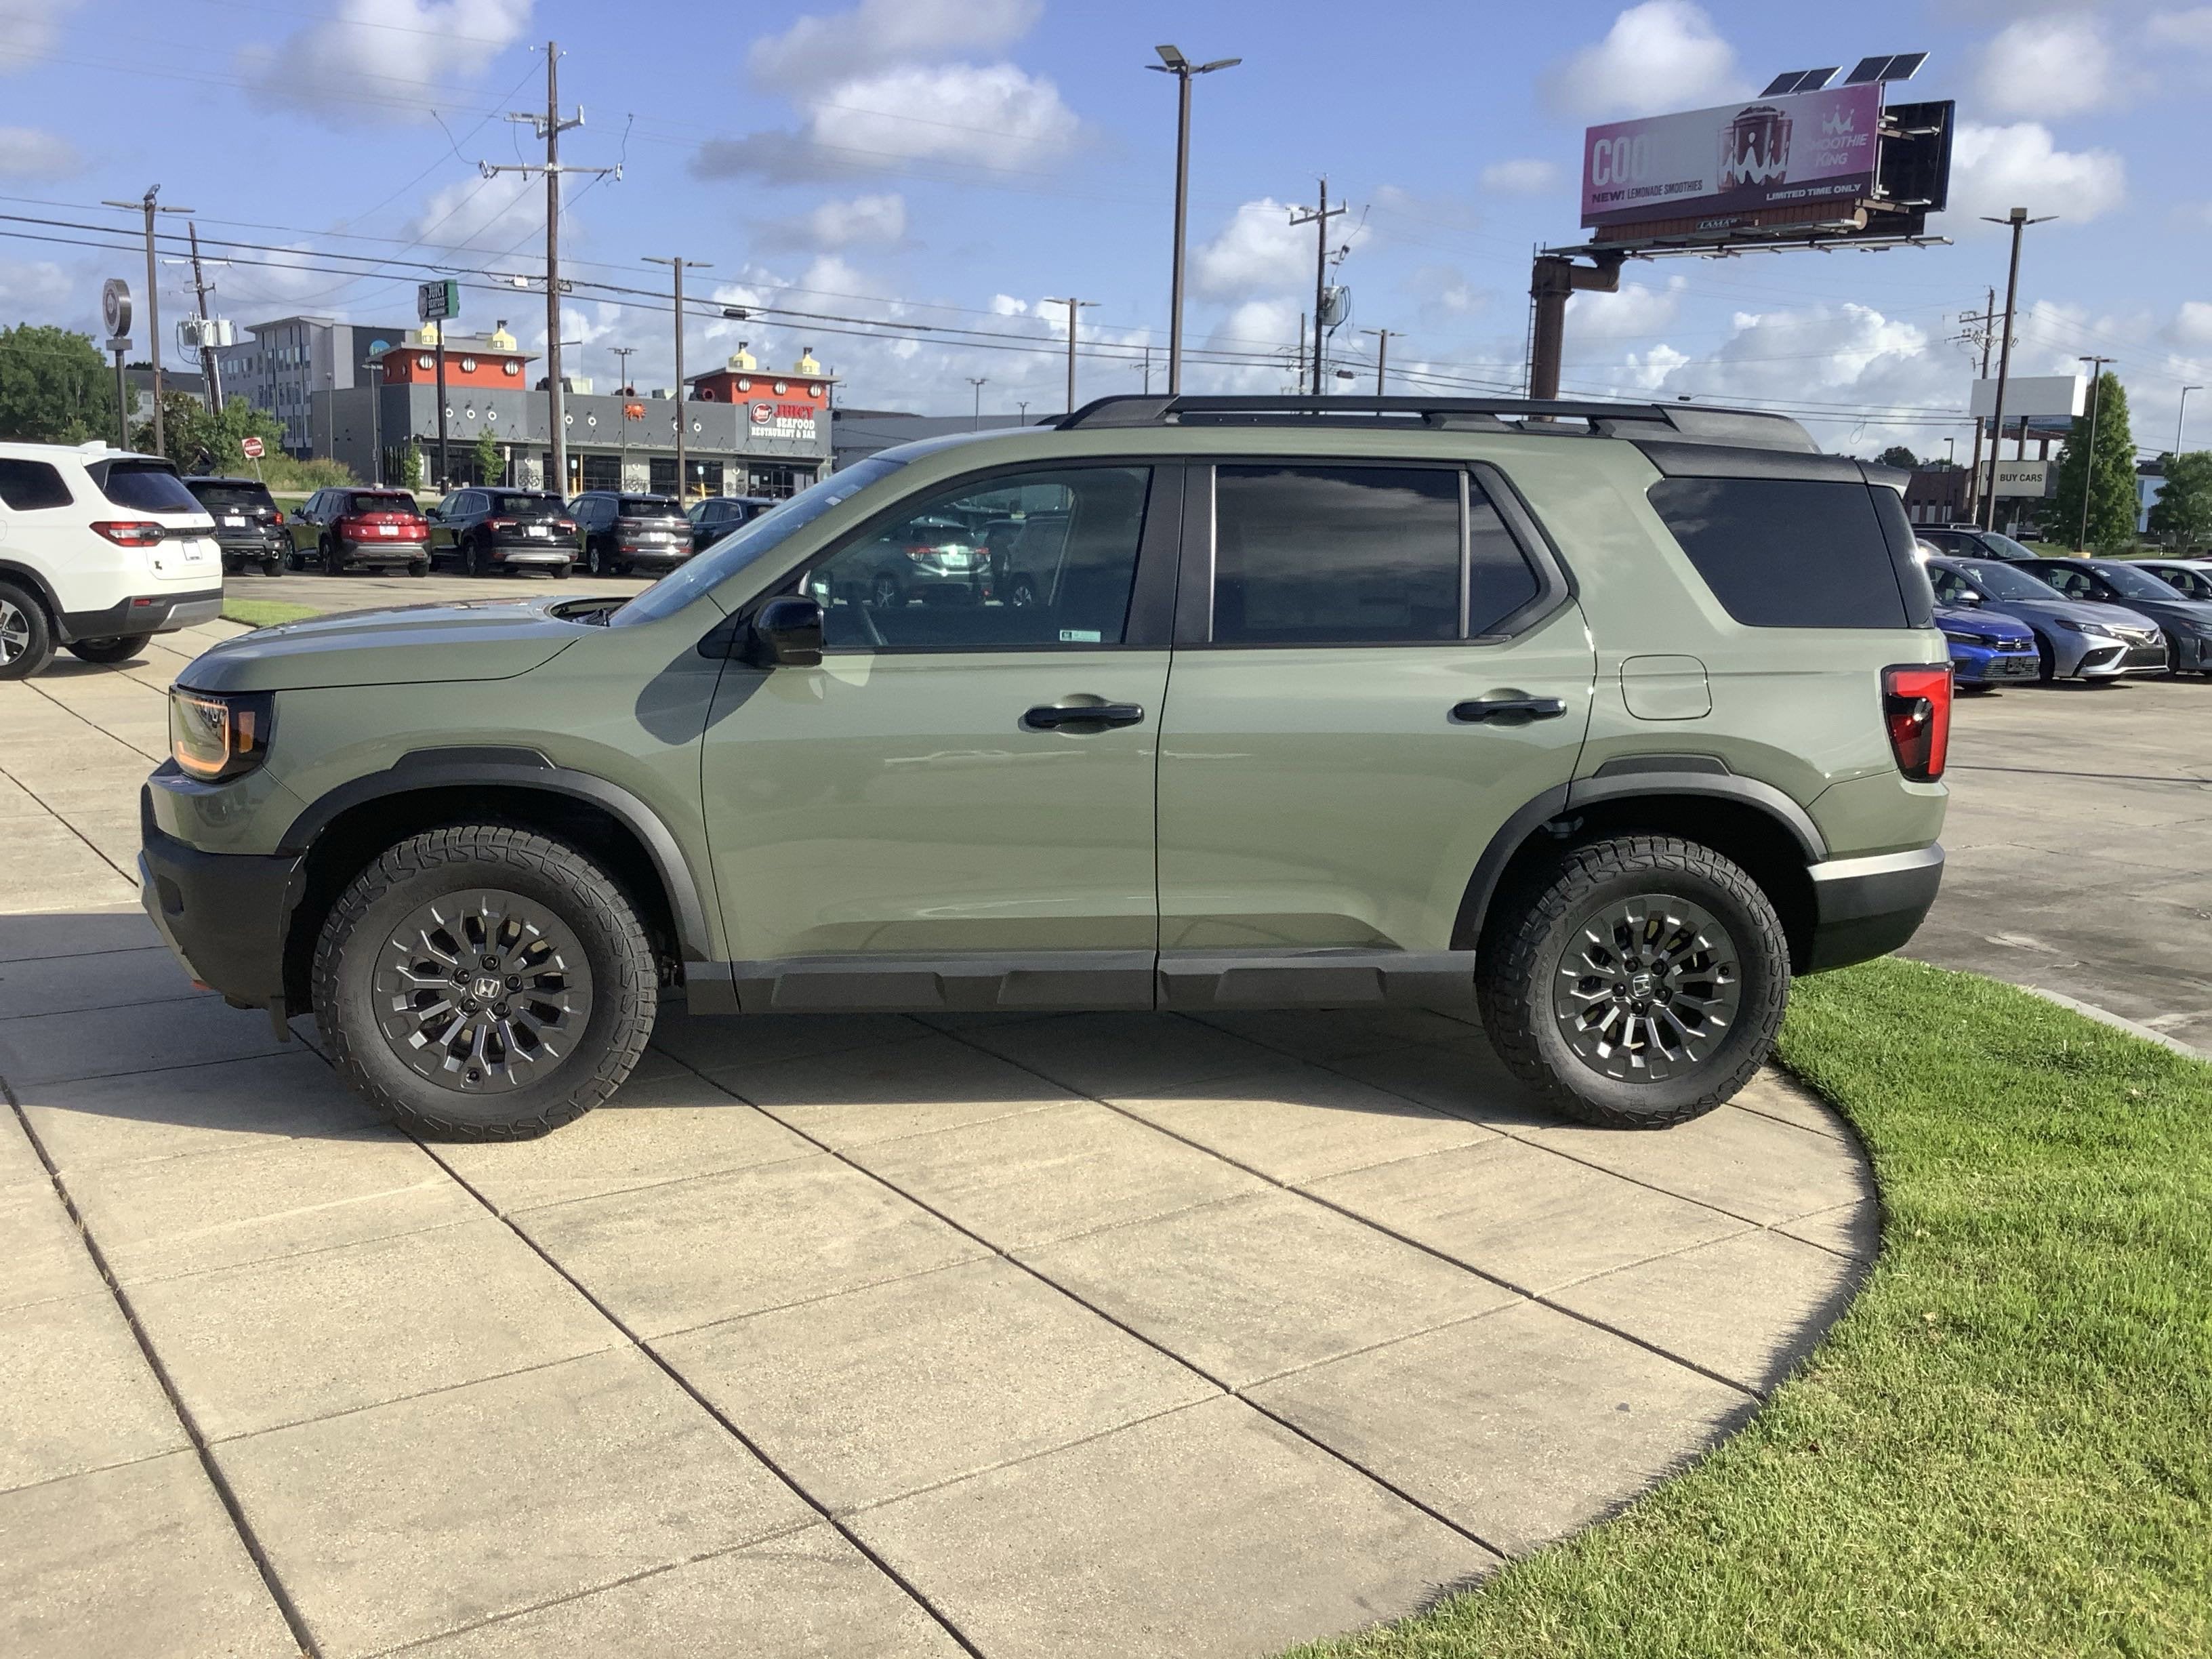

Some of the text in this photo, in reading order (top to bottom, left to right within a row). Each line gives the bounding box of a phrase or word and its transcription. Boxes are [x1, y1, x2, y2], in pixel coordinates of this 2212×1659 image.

[1816, 152, 1849, 168] KING
[1593, 179, 1703, 203] NEW! LEMONADE SMOOTHIES
[1766, 183, 1862, 201] LIMITED TIME ONLY
[776, 417, 815, 430] SEAFOOD
[751, 426, 795, 438] RESTAURANT
[2000, 474, 2043, 483] BUY CARS
